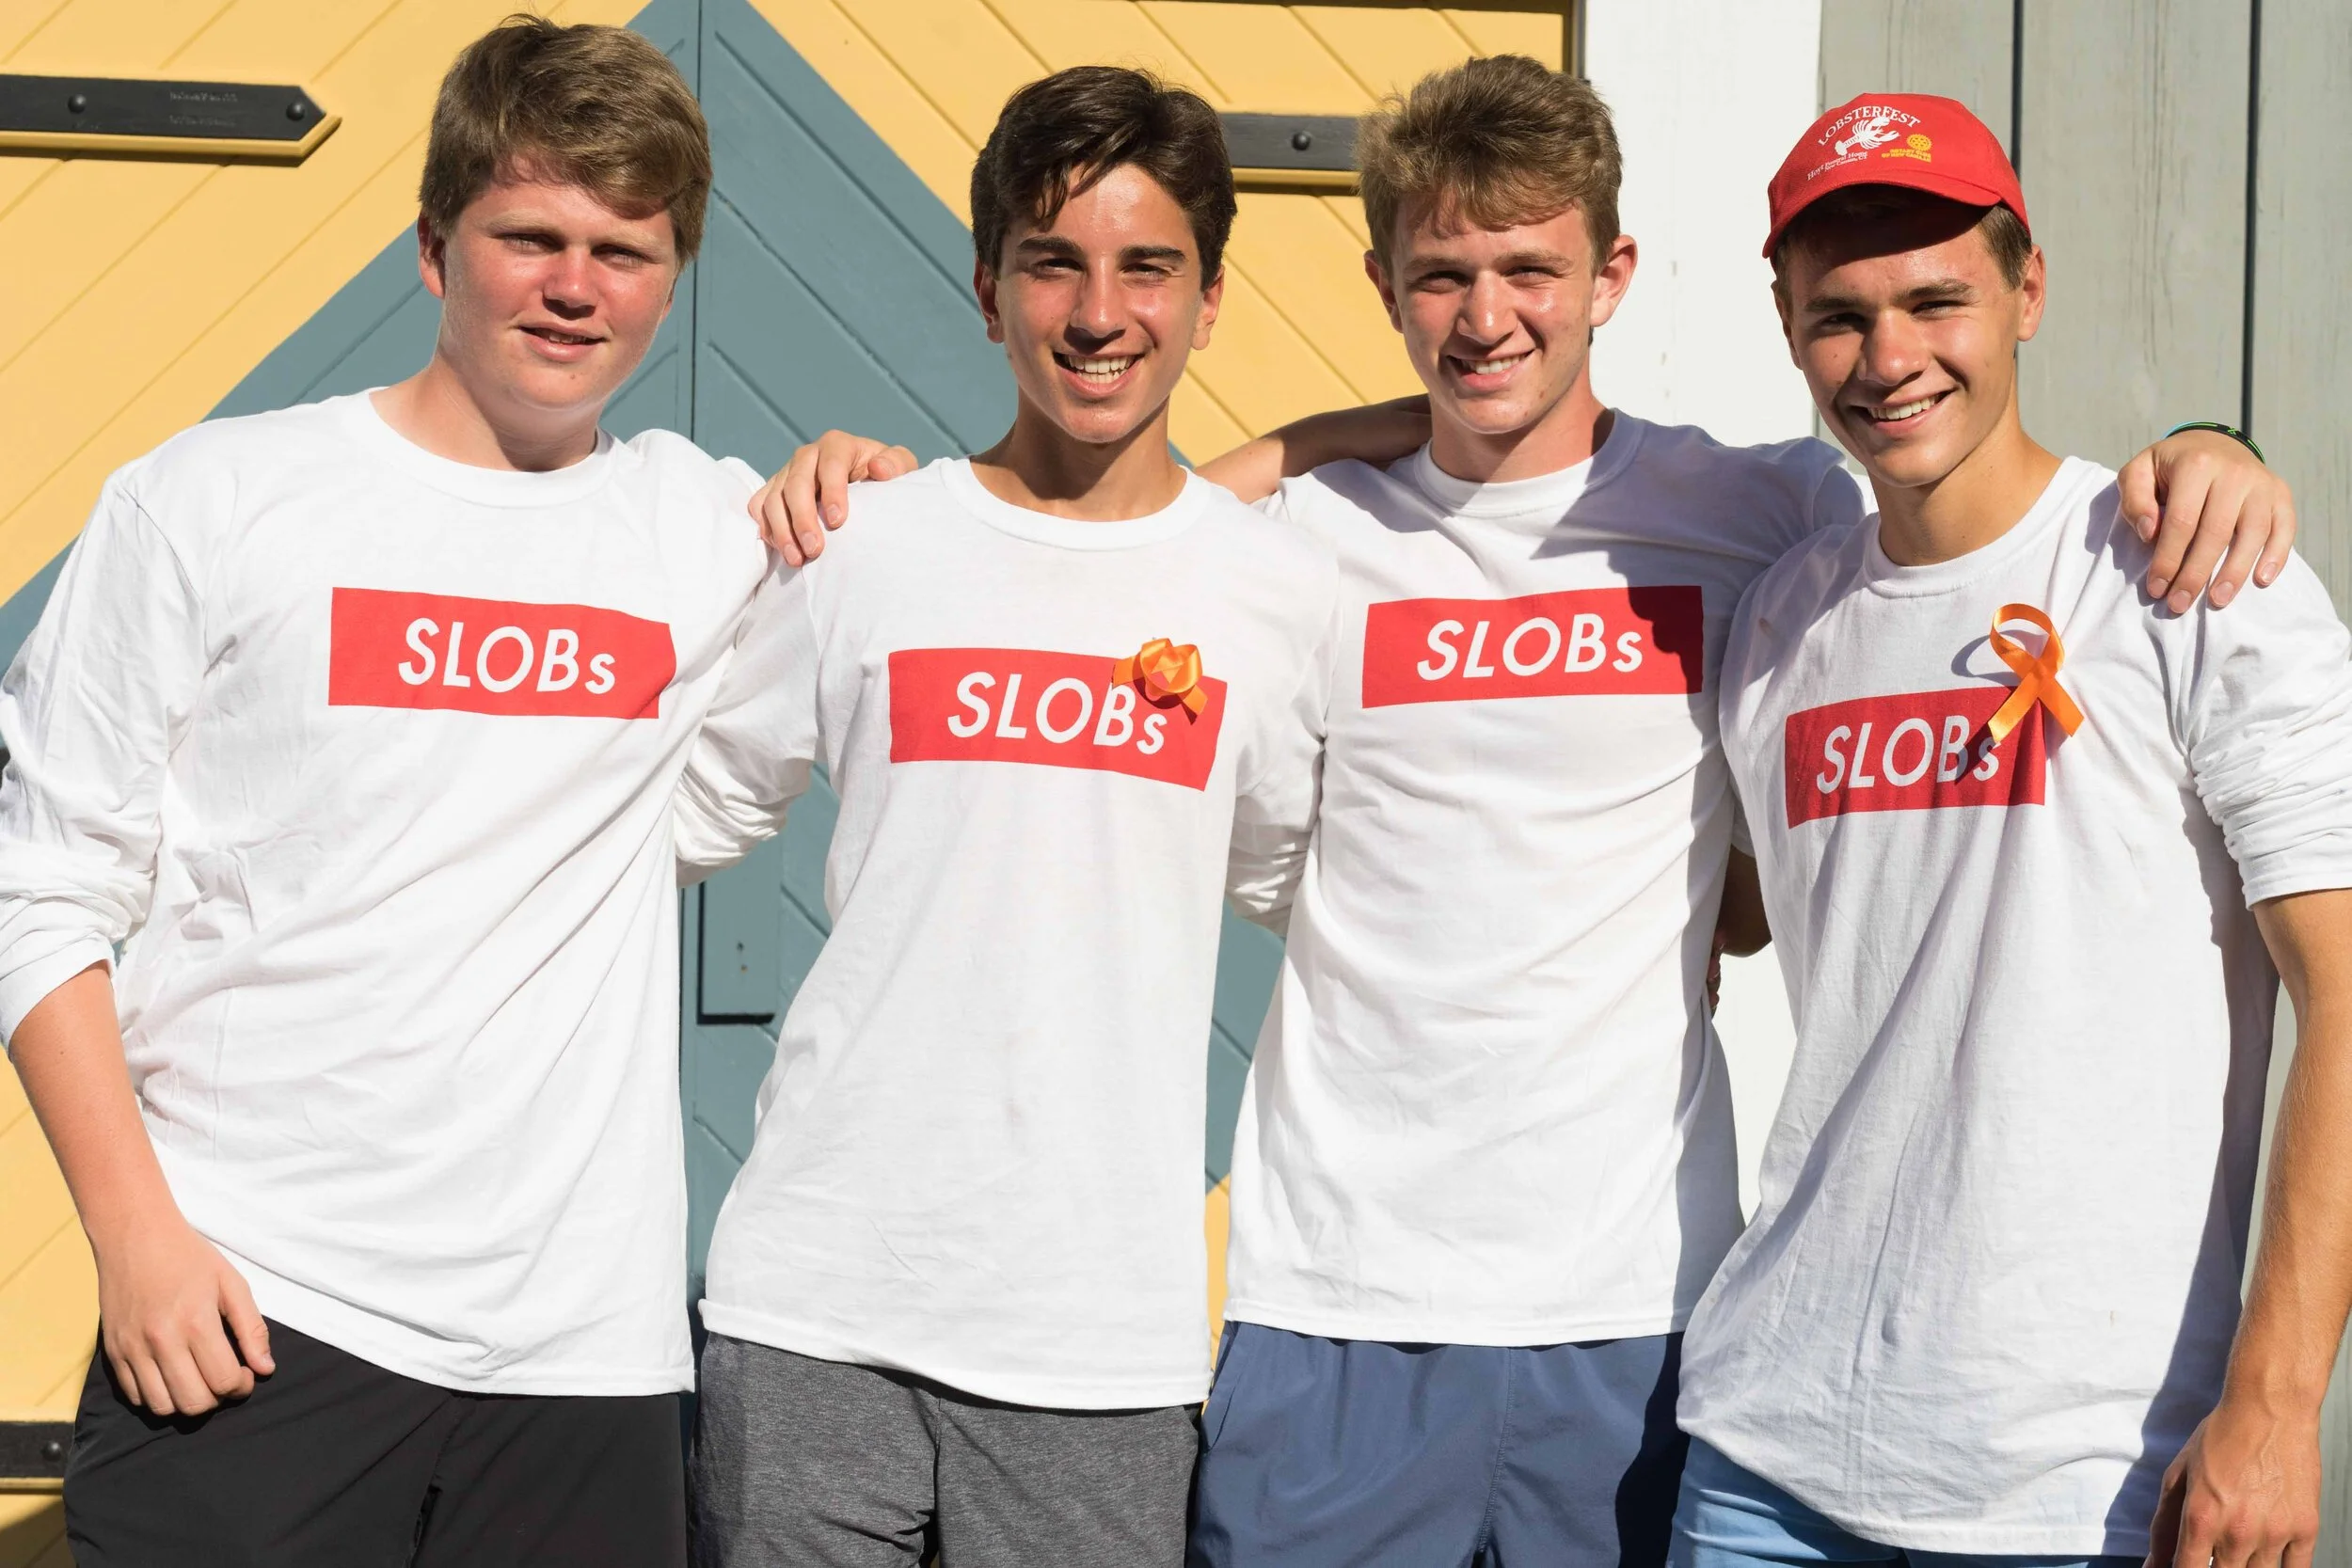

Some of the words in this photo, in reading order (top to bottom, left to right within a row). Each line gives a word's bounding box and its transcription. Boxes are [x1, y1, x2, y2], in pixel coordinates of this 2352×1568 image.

[1818, 105, 1921, 146] LOBSTERFEST
[1807, 164, 1824, 181] Hoyt
[398, 617, 616, 695] SLOBs
[1417, 612, 1644, 681] SLOBs
[947, 671, 1168, 755] SLOBs
[1816, 715, 2002, 794] SLOBs
